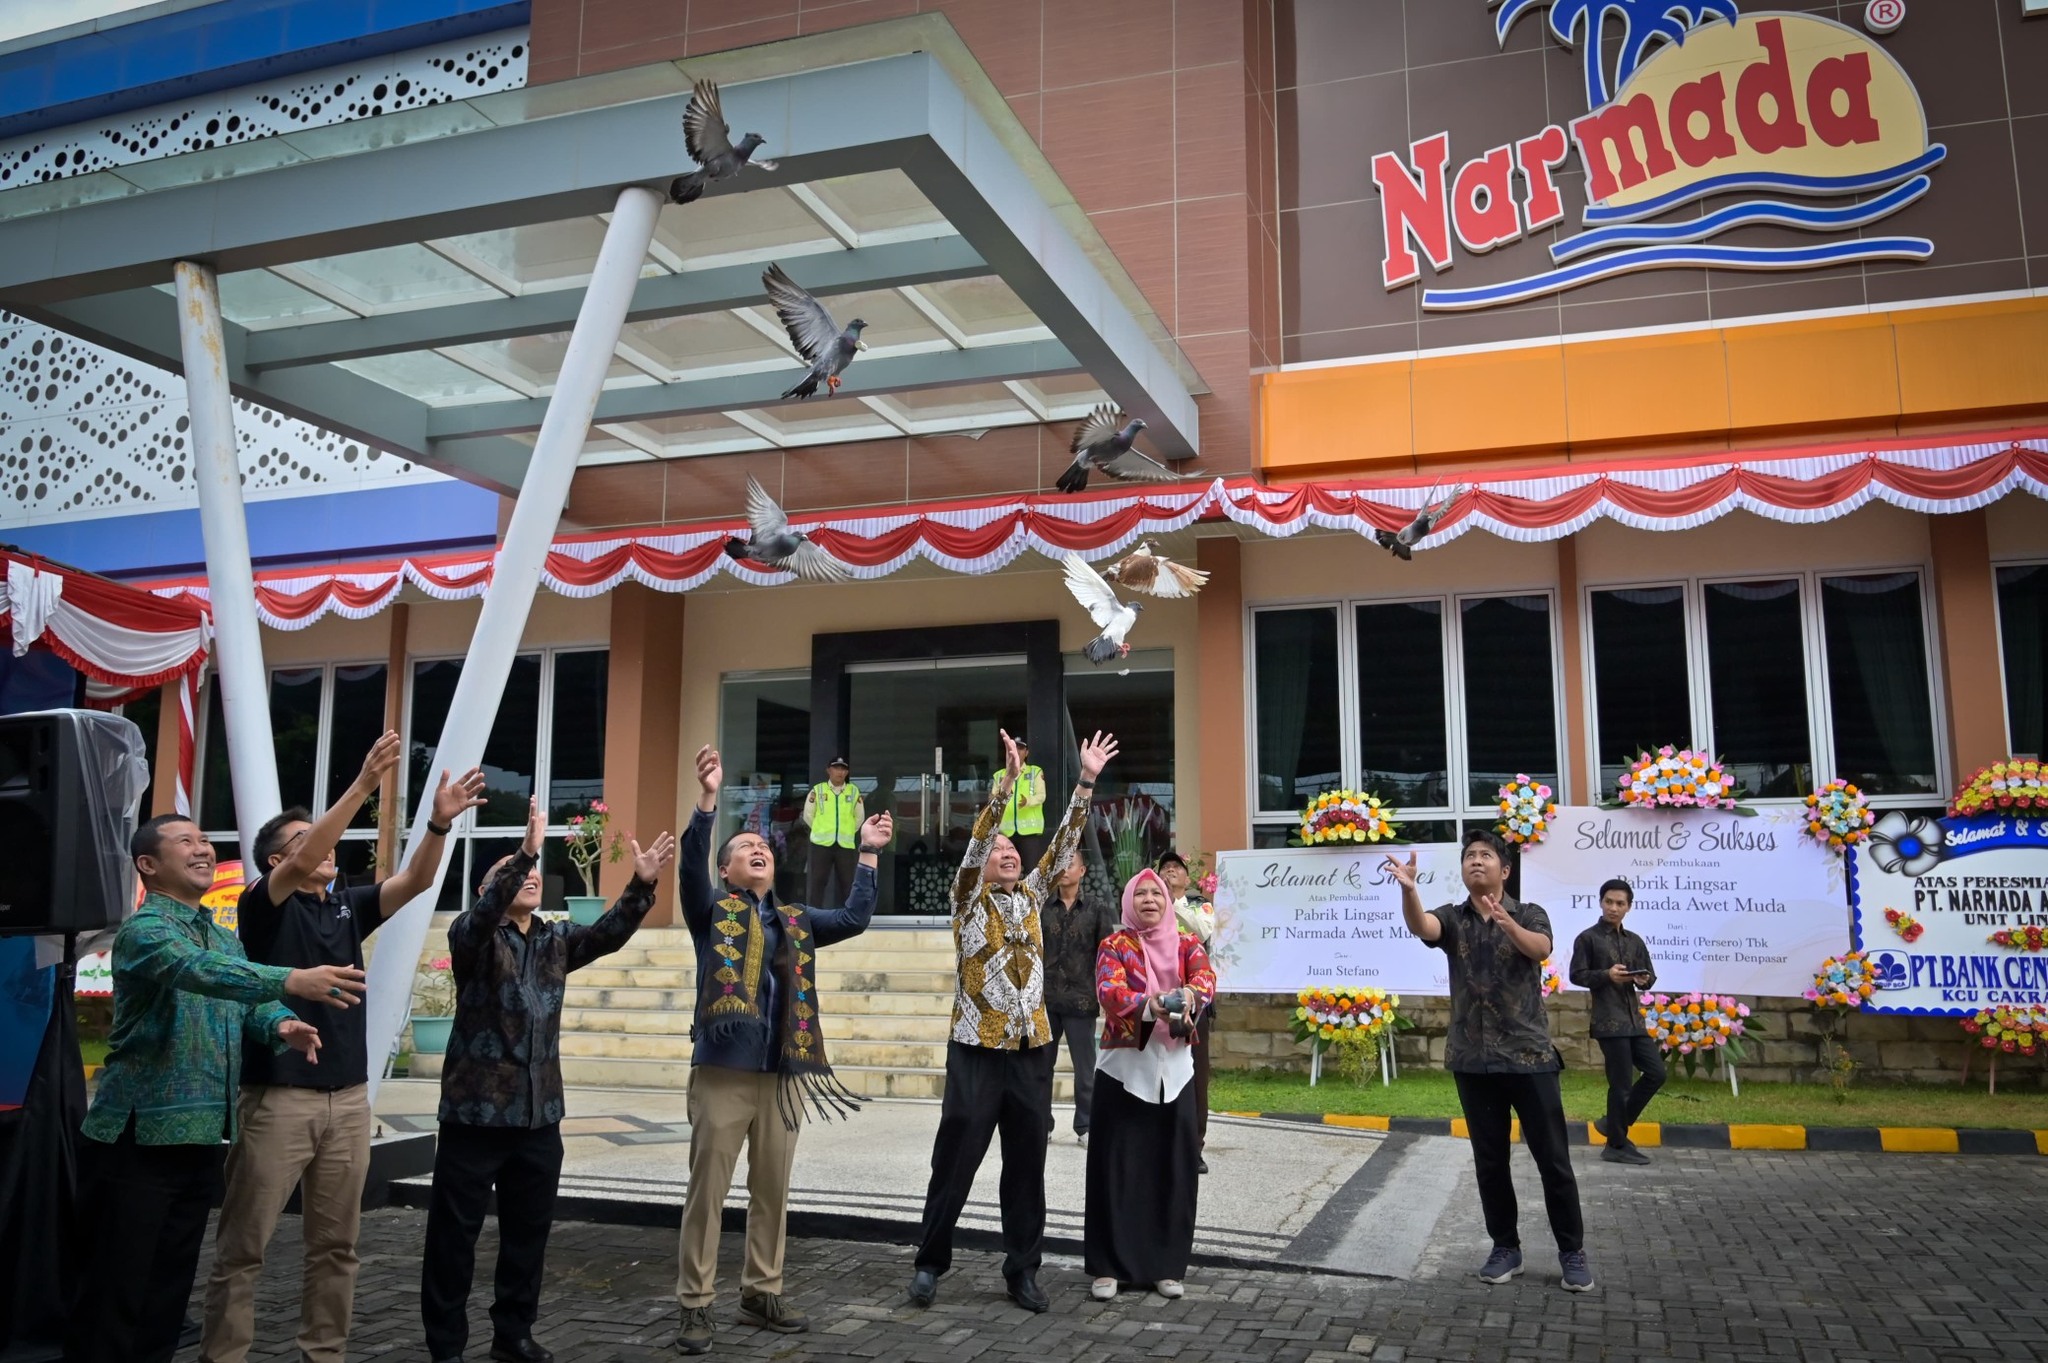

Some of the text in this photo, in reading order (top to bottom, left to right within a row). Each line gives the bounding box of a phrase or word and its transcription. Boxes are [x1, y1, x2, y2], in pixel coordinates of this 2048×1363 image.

[1372, 18, 1881, 288] Narmada
[1574, 818, 1778, 851] Selamat & Sukses
[1944, 820, 2006, 848] Selamat
[2015, 819, 2029, 837] &
[1630, 858, 1720, 868] Atas Pembukaan
[1255, 862, 1338, 888] Selamat
[1343, 861, 1362, 890] &
[1914, 876, 1957, 888] ATAS
[1675, 876, 1738, 895] Lingsar
[1308, 893, 1380, 902] Atas Pembukaan
[1571, 894, 1596, 909] PT
[1685, 897, 1728, 911] Awet
[1734, 897, 1786, 913] Muda
[1914, 889, 1943, 912] PT.
[1948, 889, 2033, 912] NARMADA
[1295, 908, 1395, 923] Pabrik Lingsar
[1963, 913, 2008, 926] UNIT
[1261, 926, 1281, 939] PT
[1285, 926, 1346, 939] Narmada
[1351, 926, 1384, 939] Awet
[1646, 936, 1768, 948] Mandiri (Persero) Tbk
[1651, 951, 1788, 965] anking Center Denpasar
[1306, 965, 1379, 976] Juan Stefano
[2004, 956, 2048, 990] CEN
[1942, 989, 1979, 1002] KCU
